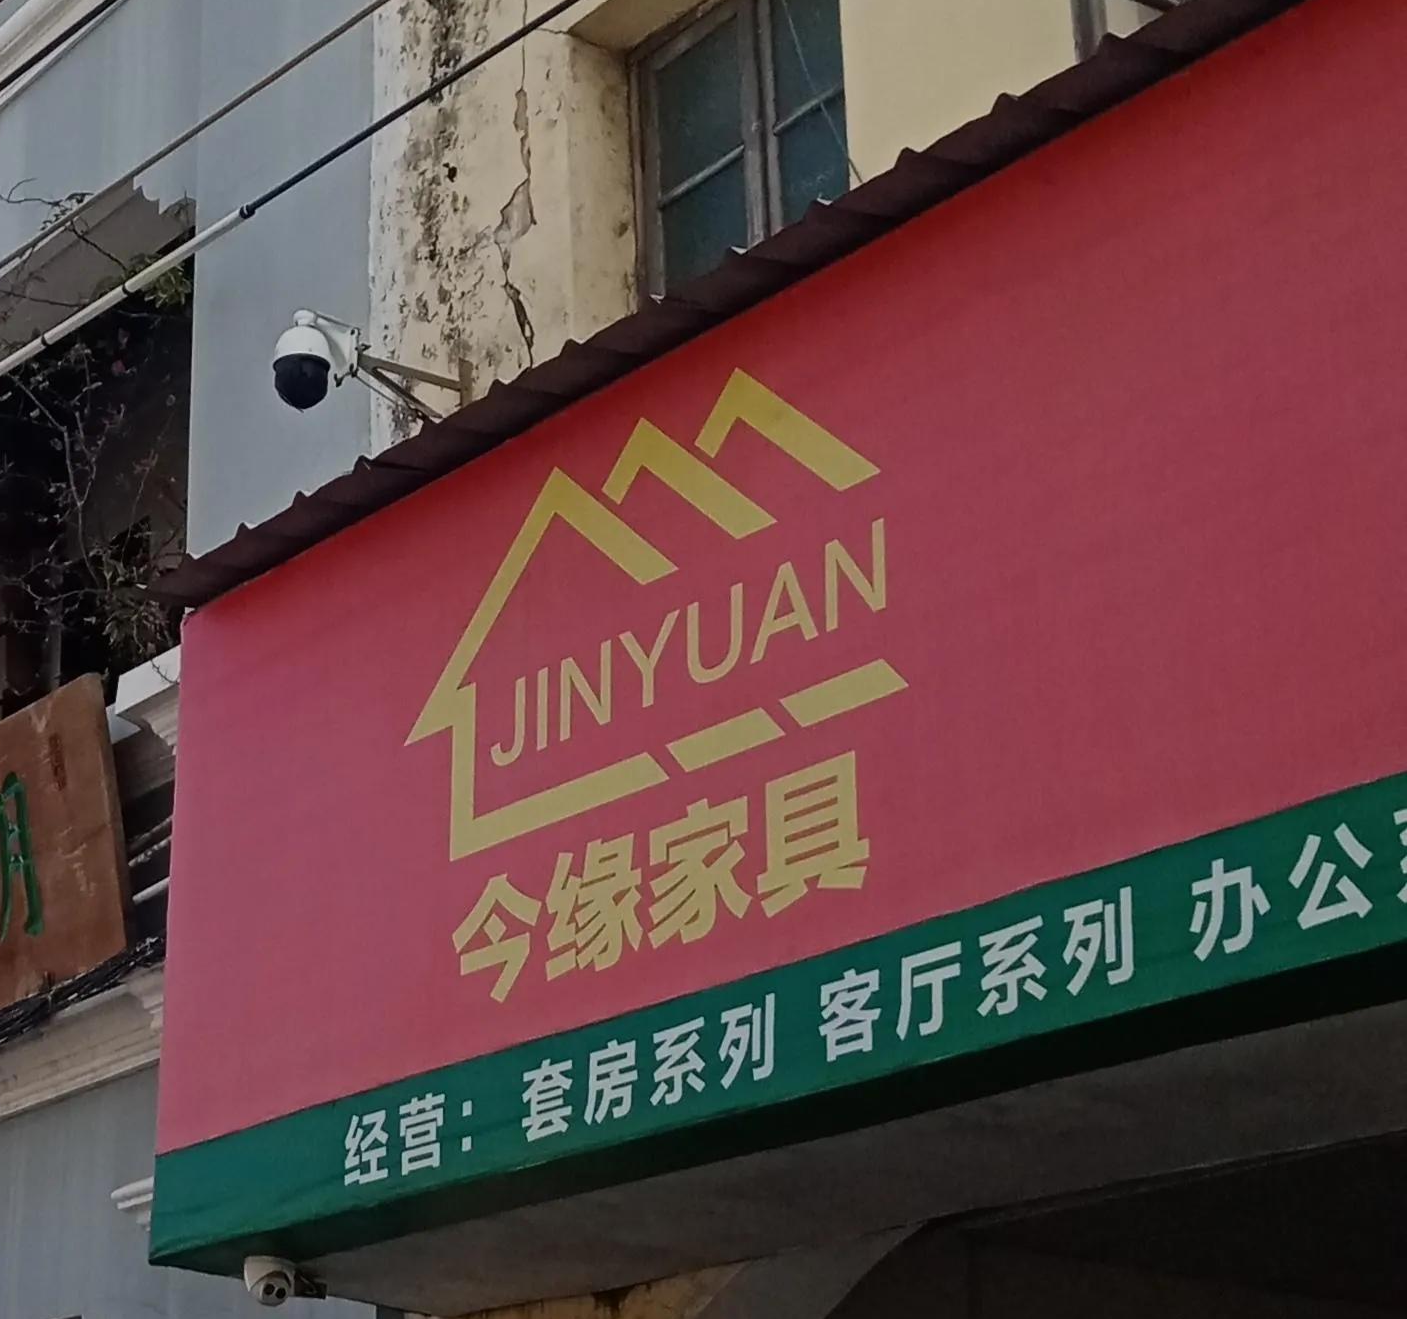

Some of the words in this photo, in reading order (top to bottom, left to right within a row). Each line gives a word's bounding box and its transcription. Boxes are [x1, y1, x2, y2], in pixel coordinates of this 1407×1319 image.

[489, 519, 887, 767] JINYUAN
[451, 751, 871, 1002] 今缘家具
[820, 887, 1134, 1062] 客厅系列
